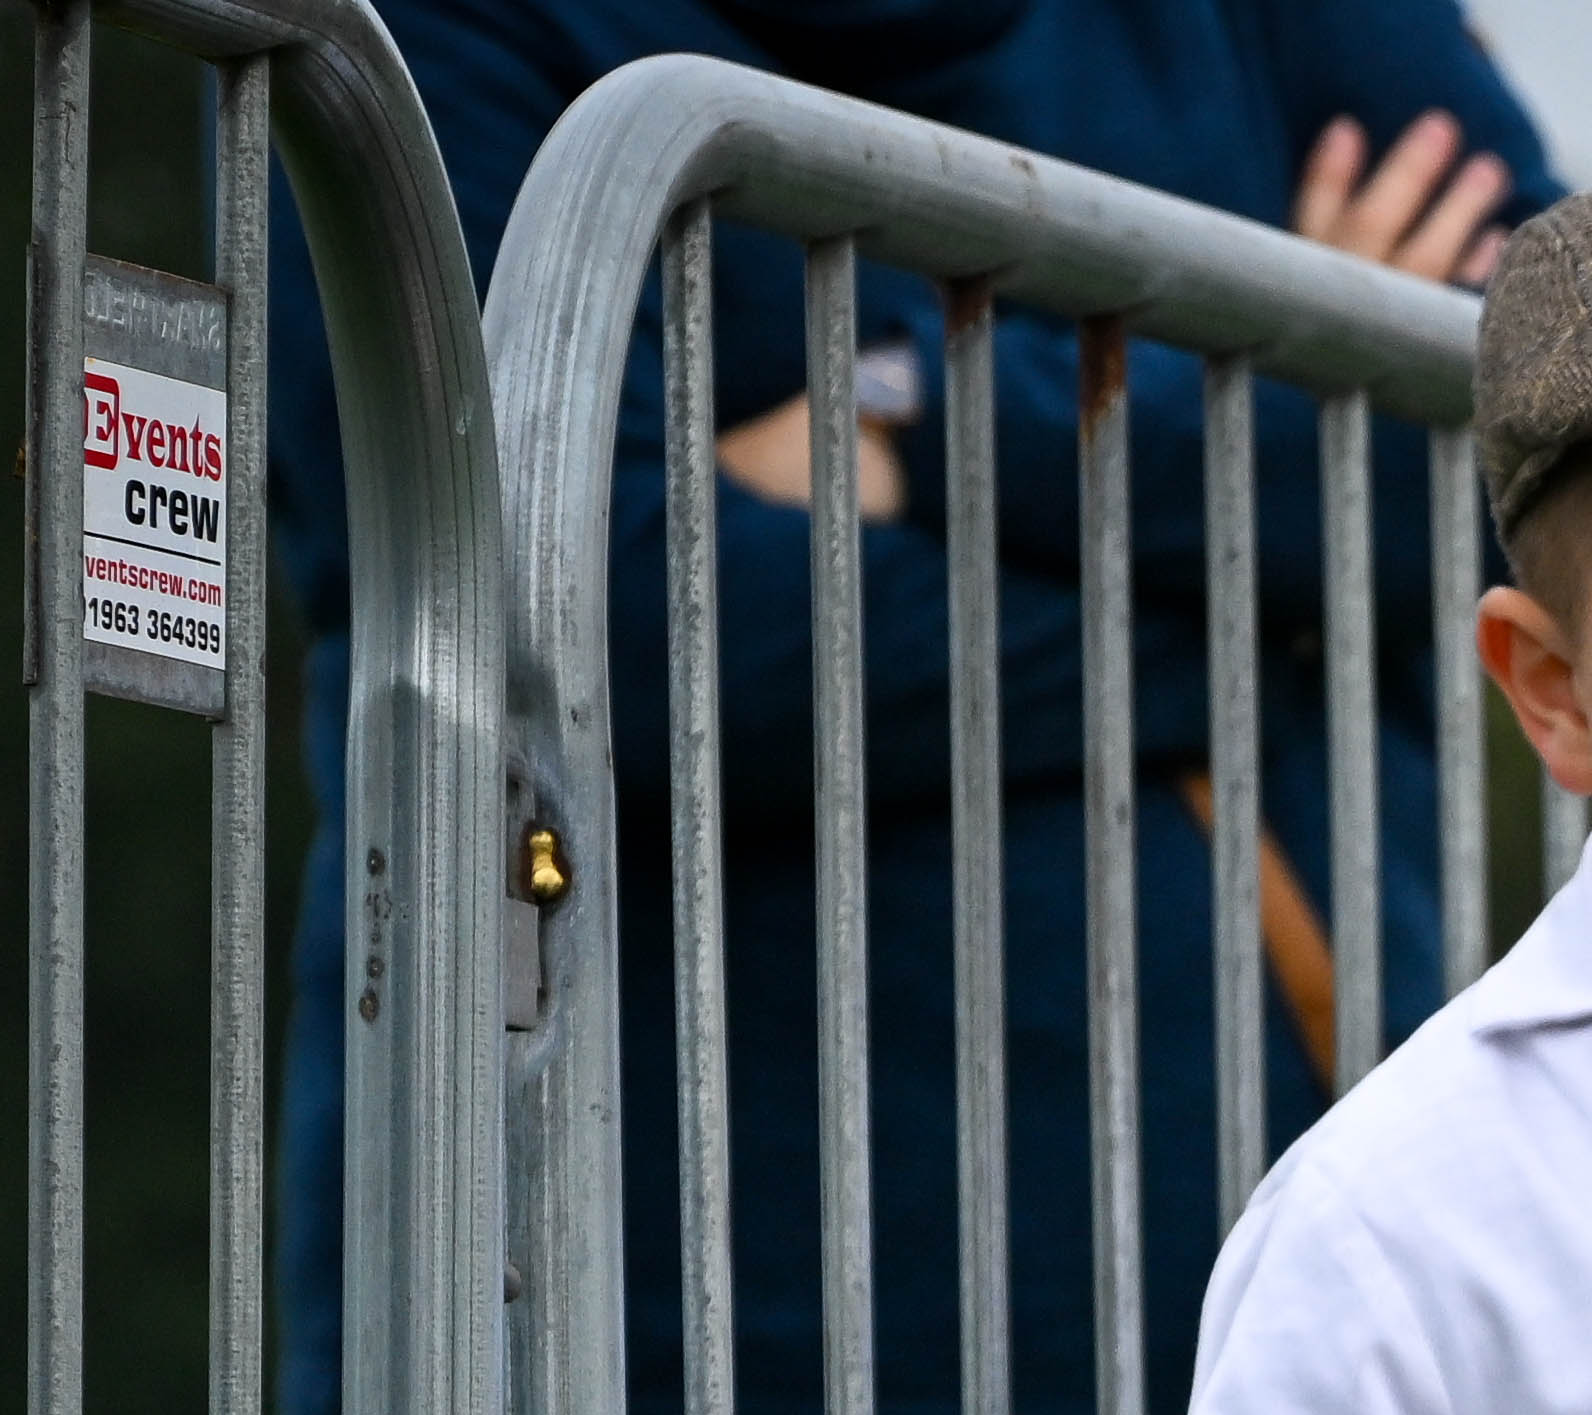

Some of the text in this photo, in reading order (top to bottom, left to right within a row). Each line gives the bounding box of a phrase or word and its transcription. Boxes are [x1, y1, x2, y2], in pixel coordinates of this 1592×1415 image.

[83, 383, 222, 482] Events
[124, 478, 220, 543] crew
[83, 594, 221, 655] 1963 364399
